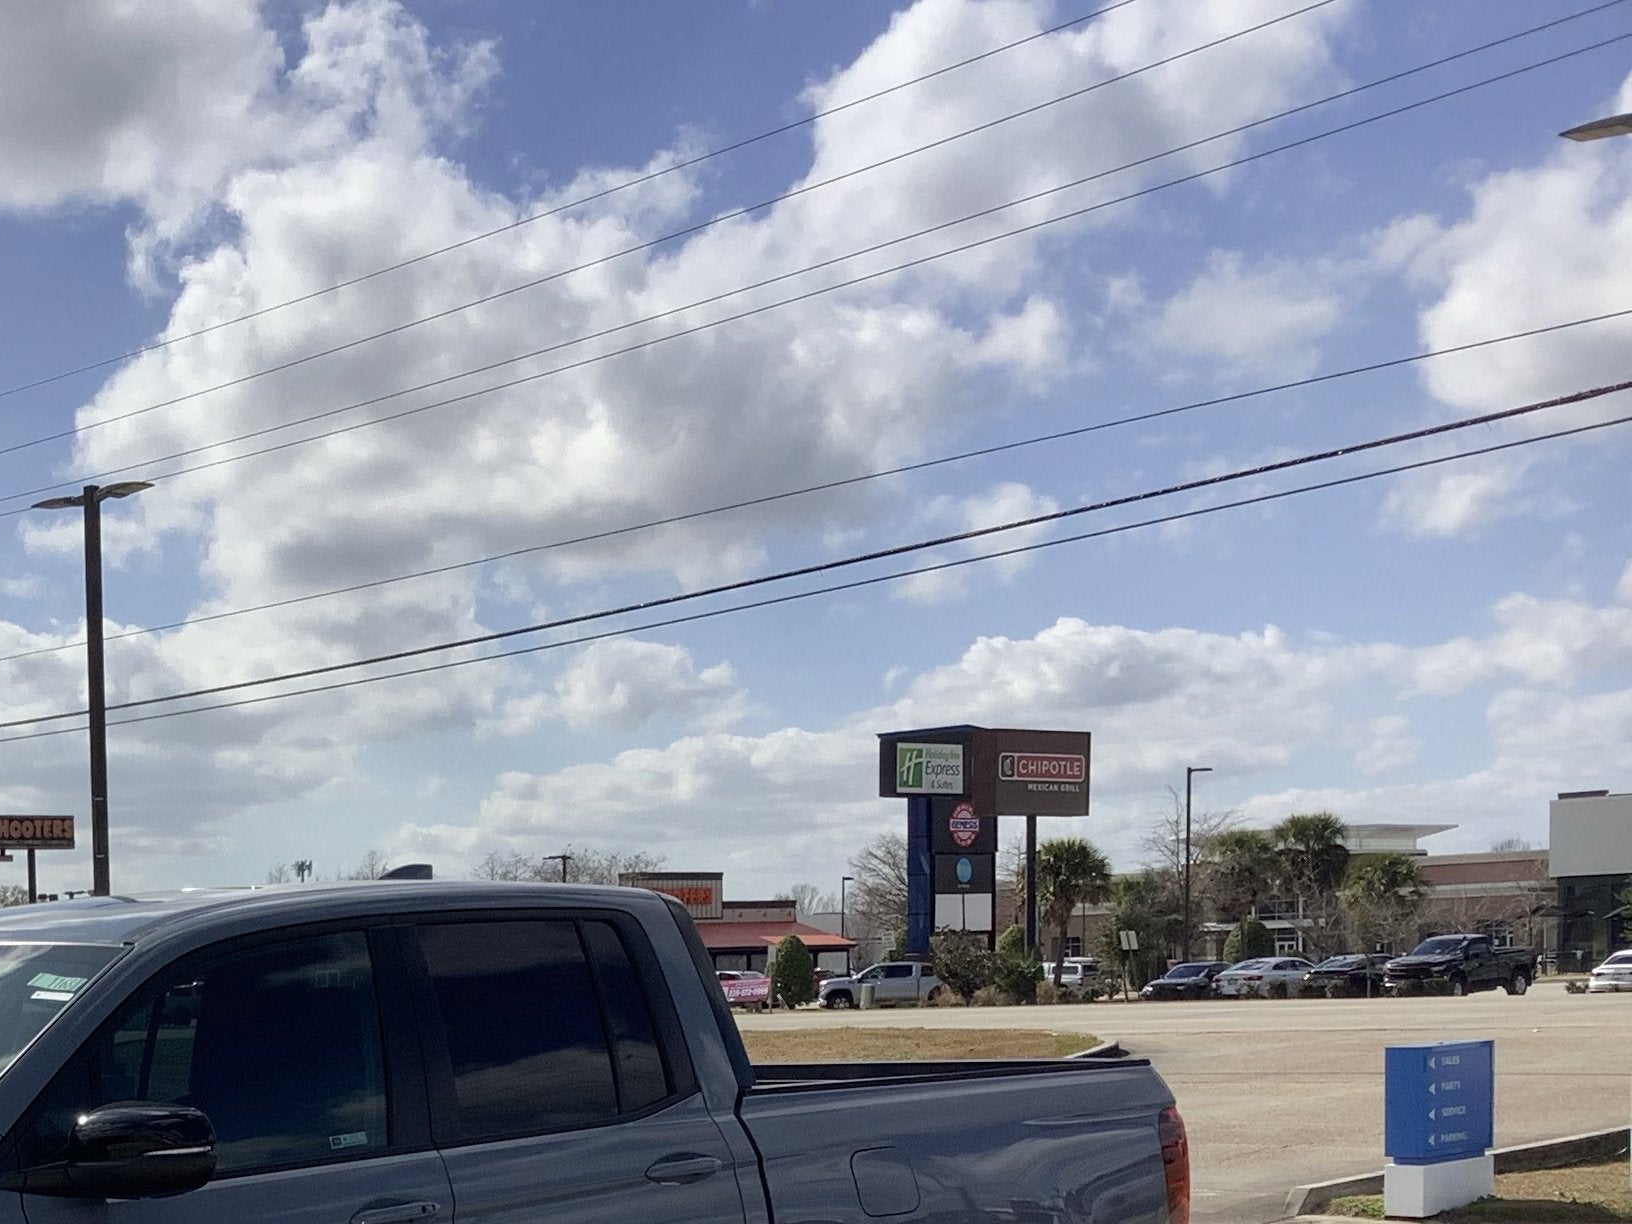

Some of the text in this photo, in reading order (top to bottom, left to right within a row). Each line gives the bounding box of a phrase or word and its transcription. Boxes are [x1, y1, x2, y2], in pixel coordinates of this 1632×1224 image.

[925, 748, 960, 761] Holiday Inn
[925, 761, 960, 778] Express
[1019, 760, 1081, 775] CHIPOTLE
[937, 780, 953, 789] Suites
[1028, 783, 1059, 791] MEXICAN
[1441, 1055, 1460, 1066] SALES
[1441, 1105, 1466, 1117] SERVICE
